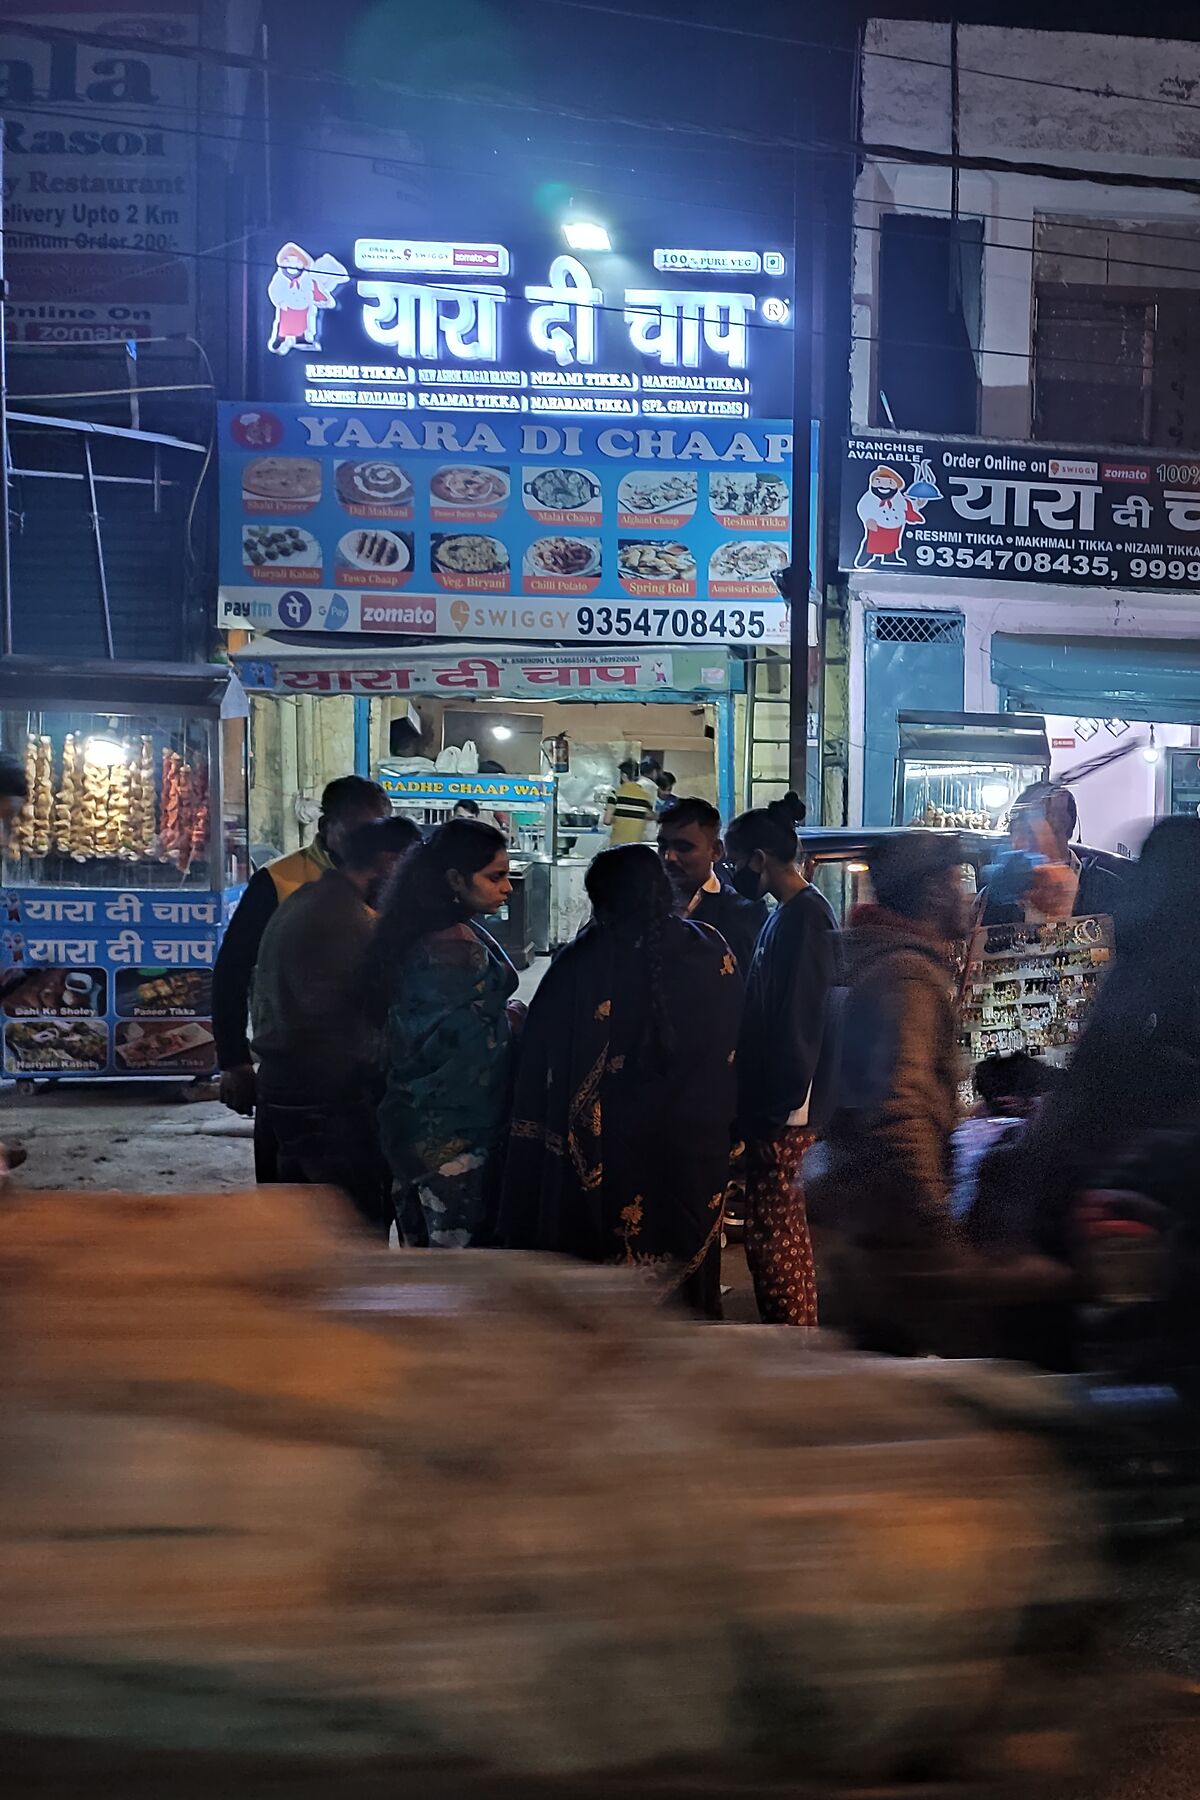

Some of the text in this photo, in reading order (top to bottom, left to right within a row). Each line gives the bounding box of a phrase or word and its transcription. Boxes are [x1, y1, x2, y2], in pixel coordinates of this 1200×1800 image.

[28, 170, 184, 195] Restaurant
[2, 203, 178, 228] elivery Upto 2 Km
[4, 233, 68, 249] nimum
[700, 257, 728, 266] PURE
[730, 259, 752, 267] VEG
[108, 307, 151, 321] On
[356, 254, 755, 369] यारा दी चाप
[39, 325, 137, 341] zomato
[305, 365, 407, 380] RESHMI TIKKA
[530, 372, 632, 387] NIZAMI TIKKA
[642, 375, 743, 391] MAKHMALI TIKKA
[418, 393, 520, 409] KALMAI TIKKA
[594, 398, 632, 412] TIKKA
[667, 400, 708, 414] GRAVY
[708, 401, 743, 415] ITEMS
[298, 416, 792, 464] YAARA DI CHAAP
[848, 440, 924, 453] FRANCHISE
[847, 451, 921, 463] AVAILABLE
[942, 451, 1047, 473] Order Online on
[1061, 465, 1096, 475] SWIGGY
[1104, 468, 1147, 481] zomato
[948, 476, 1103, 531] यारा
[1111, 495, 1154, 529] दी
[349, 505, 408, 518] Dal Makhani
[538, 512, 596, 525] Malai Chaap
[621, 515, 679, 527] Afghani Chaap
[722, 516, 786, 528] Reshmi Tikka
[915, 530, 962, 543] RESHMI
[965, 533, 1003, 546] TIKKA
[1014, 536, 1075, 550] MAKHMALI
[1078, 539, 1113, 552] TIKKA
[1124, 542, 1163, 555] NIZAMI
[1166, 545, 1200, 557] TIKKA
[916, 545, 1118, 581] 9354708435,
[343, 573, 398, 587] Tawa Chaap
[441, 576, 506, 590] Veg. Biryani
[530, 580, 587, 591] Chilli Potato
[629, 583, 689, 595] Spring Roll
[224, 600, 272, 617] paytm
[331, 607, 347, 619] Pay
[363, 606, 434, 624] zomato
[474, 608, 570, 629] SWIGGY
[577, 606, 765, 638] 9354708435
[280, 659, 642, 690] यारा दी चाप
[382, 780, 553, 797] RADHE CHAAP WAL
[24, 893, 216, 924] यारा दी चाप
[27, 930, 215, 963] यारा दी चाप
[61, 1007, 96, 1018] Sholey
[133, 1007, 195, 1016] Paneer Tikka
